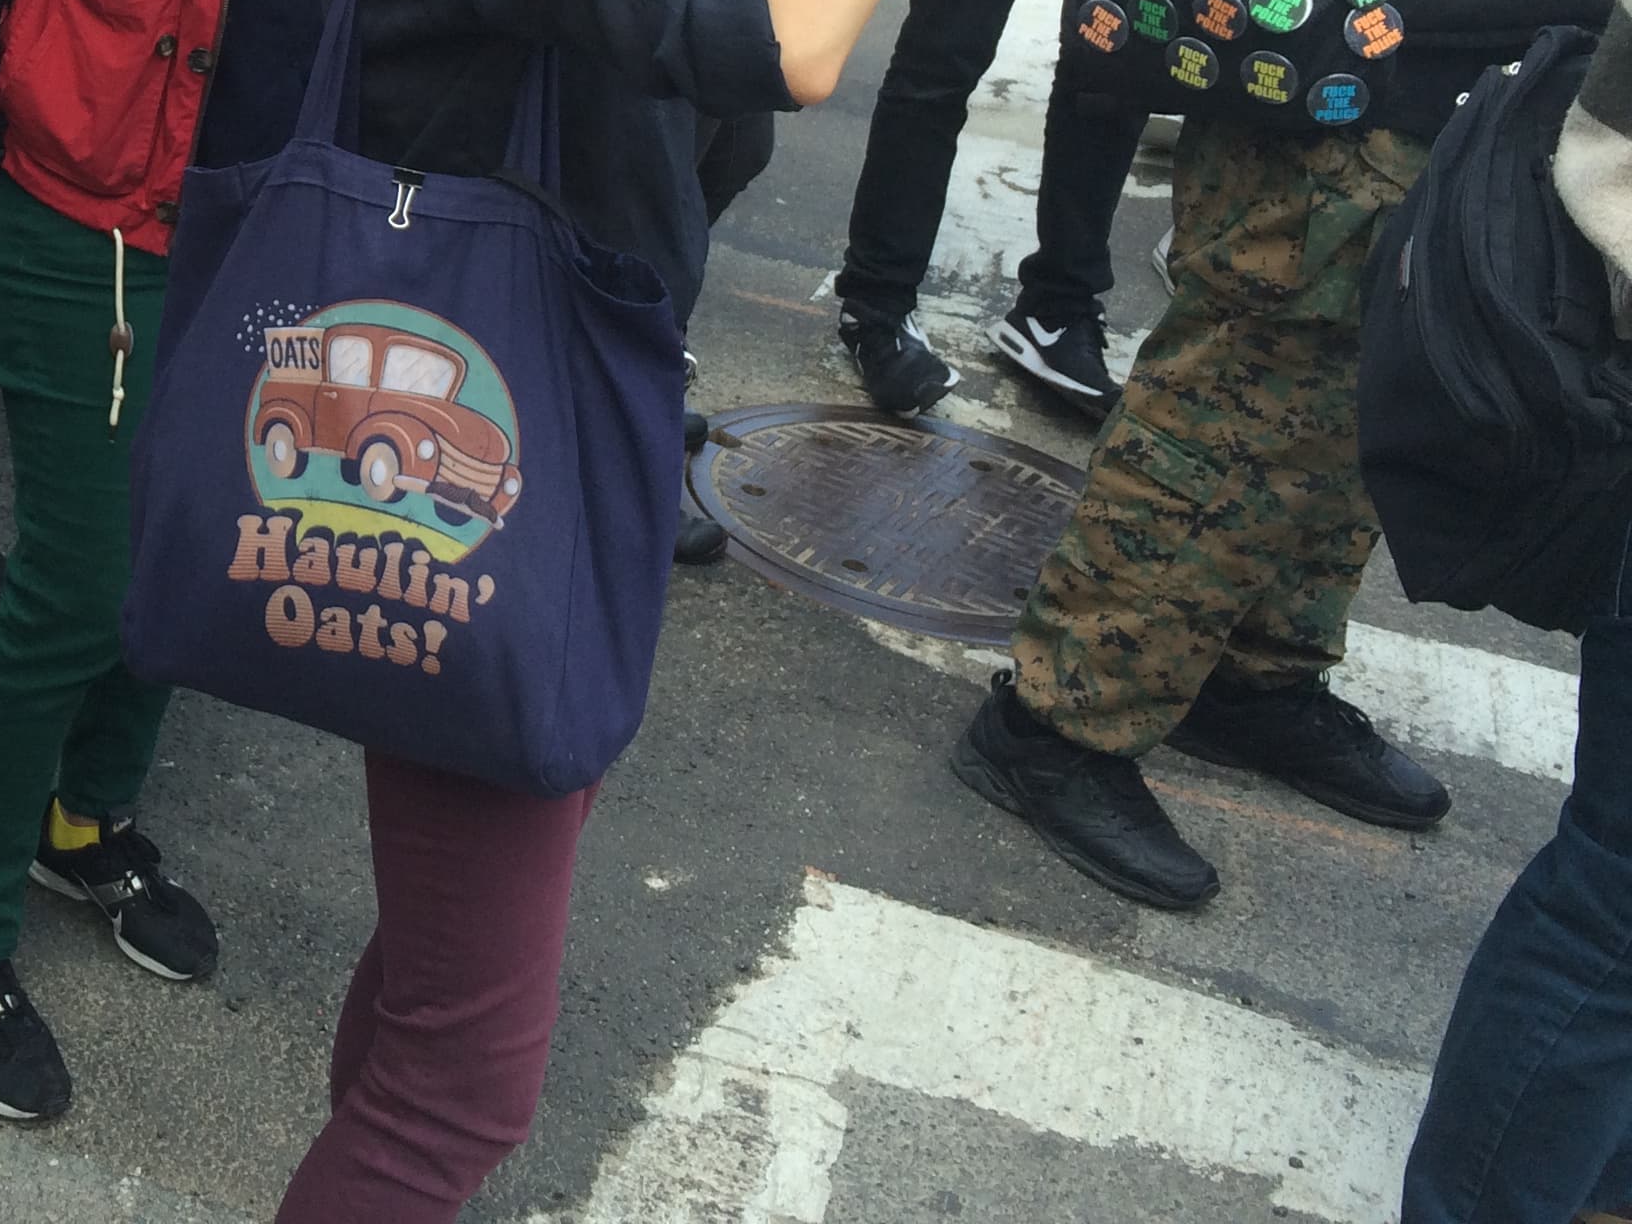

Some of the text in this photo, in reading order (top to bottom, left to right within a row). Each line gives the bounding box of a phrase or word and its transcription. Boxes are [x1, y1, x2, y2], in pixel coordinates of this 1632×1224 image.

[270, 336, 320, 371] OATS
[227, 514, 495, 623] Haulin'
[264, 585, 448, 675] Oats!
